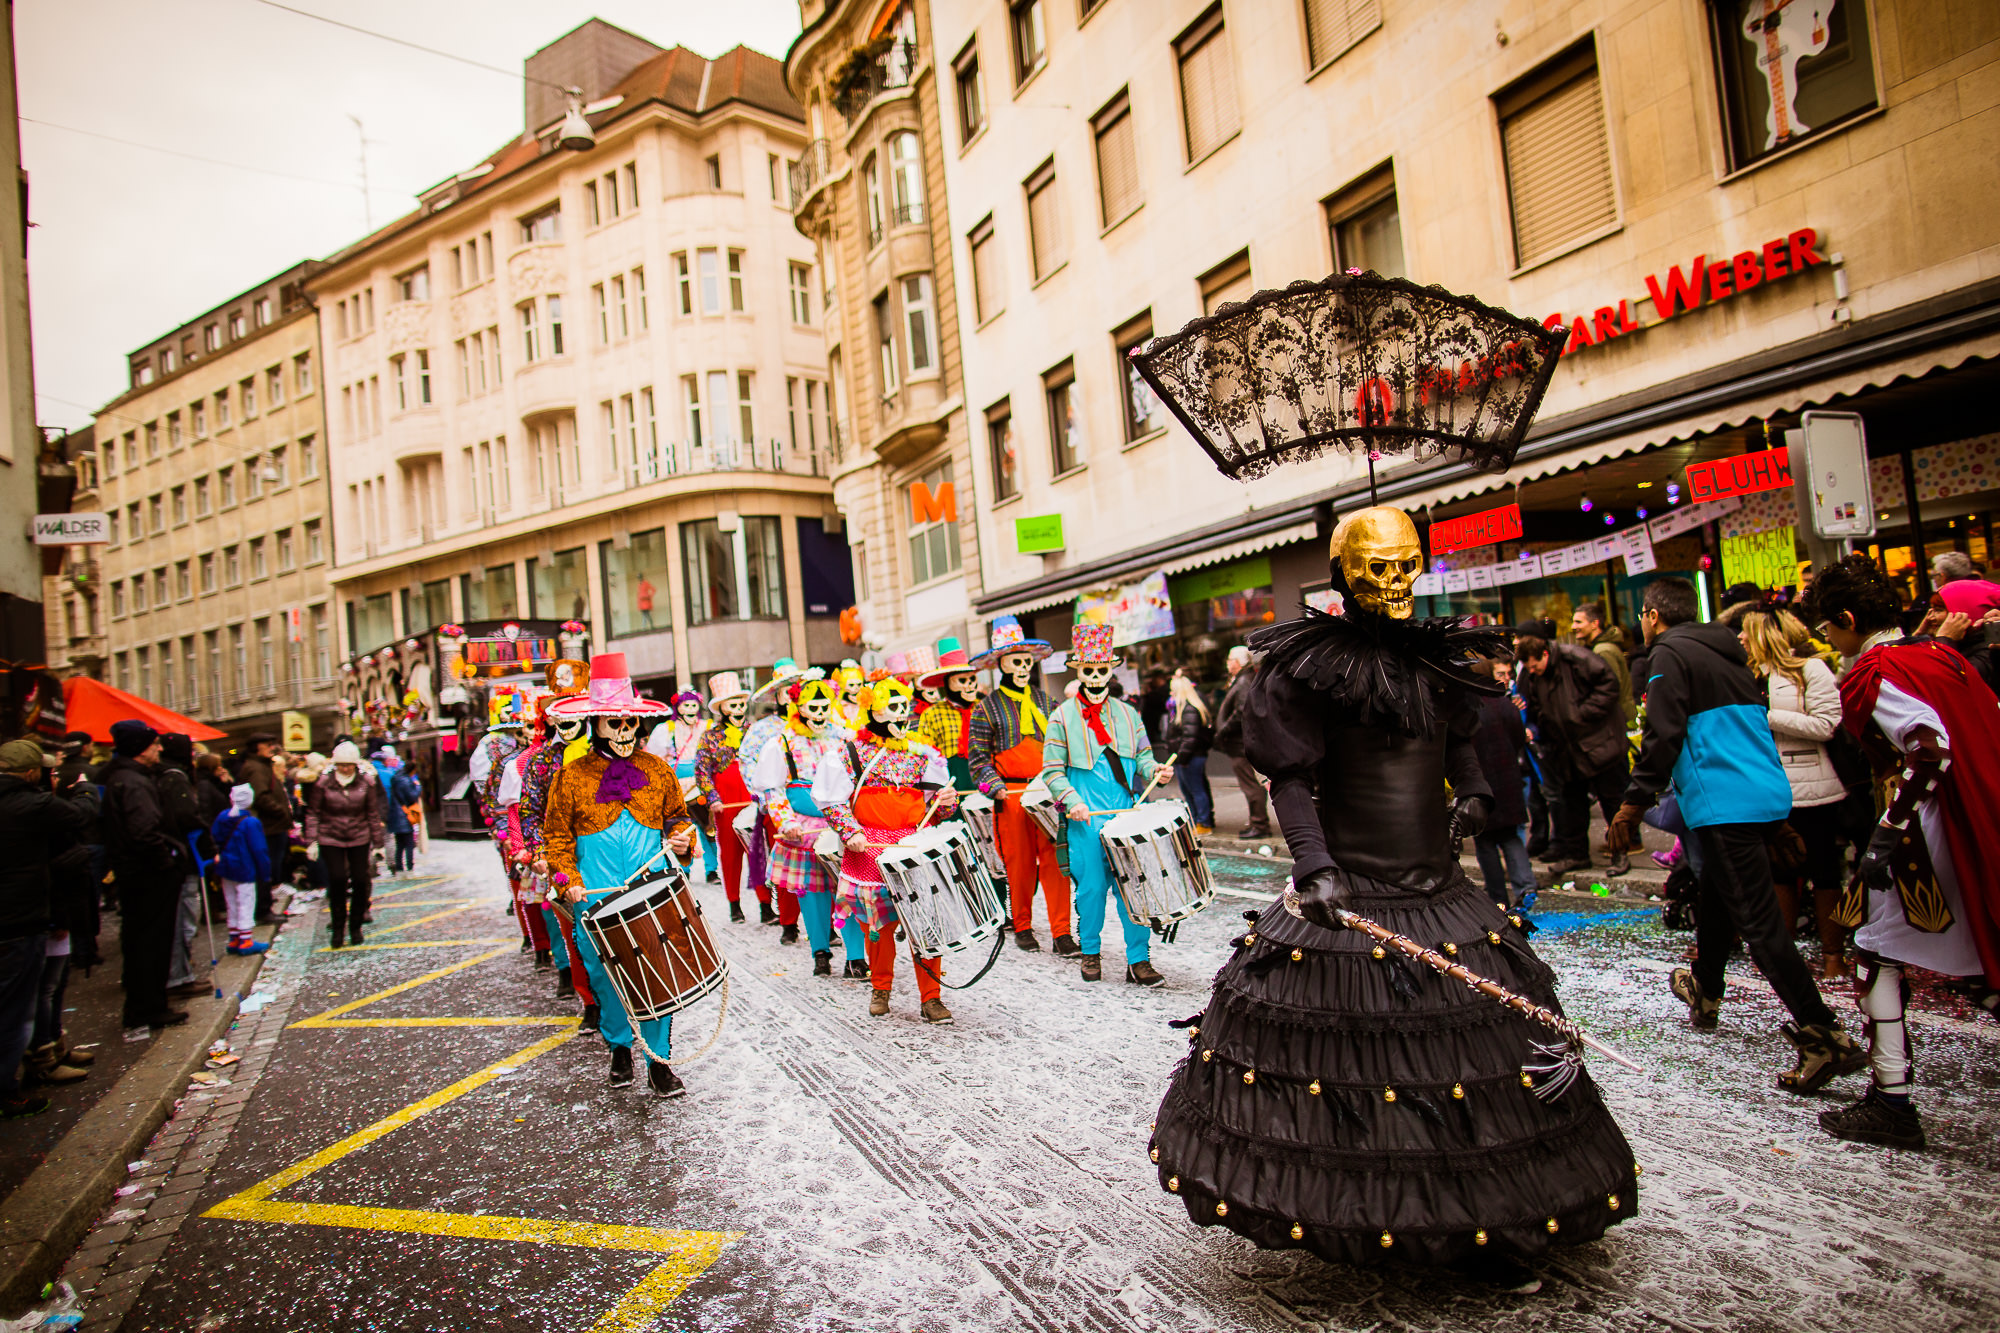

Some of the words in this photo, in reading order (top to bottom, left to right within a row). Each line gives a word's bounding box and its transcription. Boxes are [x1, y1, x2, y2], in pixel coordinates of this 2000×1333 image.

[1645, 227, 1822, 319] WEBER
[910, 481, 957, 523] M
[37, 519, 101, 535] WALDER
